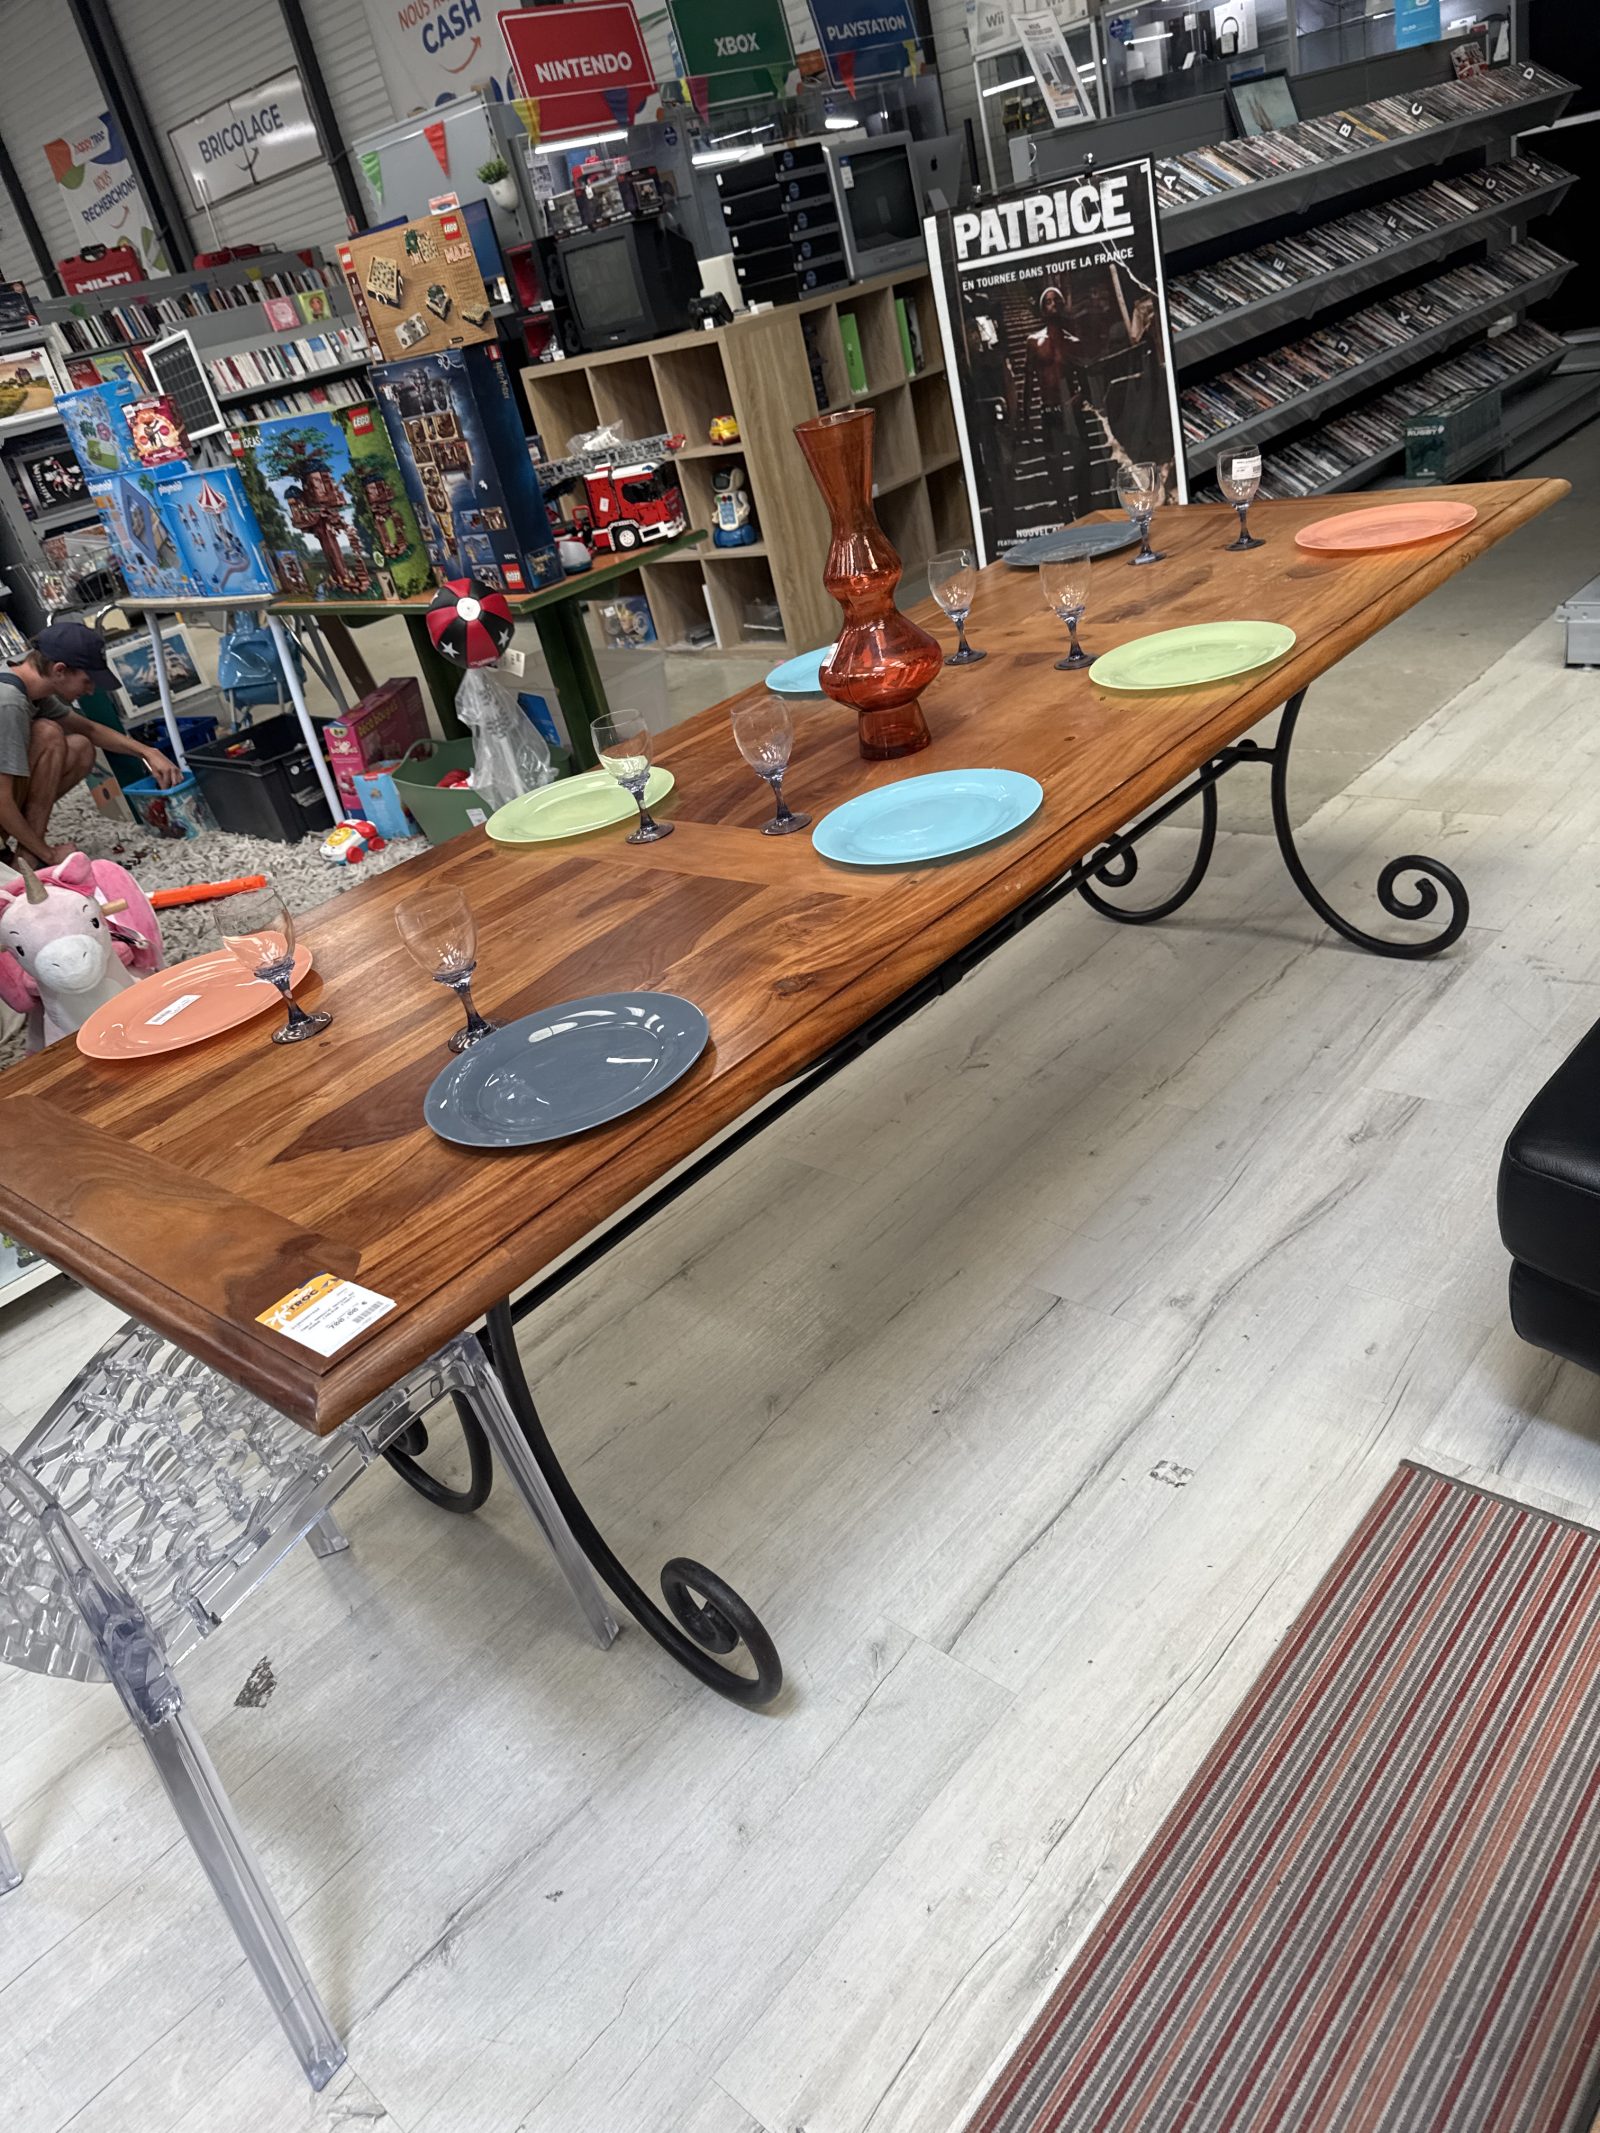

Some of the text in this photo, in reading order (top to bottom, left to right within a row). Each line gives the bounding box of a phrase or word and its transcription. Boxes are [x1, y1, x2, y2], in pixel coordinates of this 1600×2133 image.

[422, 0, 481, 53] CASH
[986, 10, 1005, 28] Wii
[826, 15, 907, 41] PLAYSTATION
[714, 32, 760, 57] XBOX
[534, 51, 633, 84] NINTENDO
[1523, 66, 1535, 80] D
[1411, 102, 1423, 116] C
[198, 104, 284, 164] BRICOLAGE
[1338, 122, 1352, 138] B
[1528, 162, 1541, 176] H
[1163, 173, 1177, 190] A
[952, 175, 1132, 260] PATRICE
[1386, 215, 1397, 229] F
[962, 247, 1135, 292] EN TOURNEE DANS TOUTE LA FRANCE
[1273, 257, 1286, 272] E
[1419, 304, 1431, 314] L
[1397, 311, 1411, 325] K
[353, 415, 370, 428] LEGO
[287, 1289, 320, 1312] TROC
